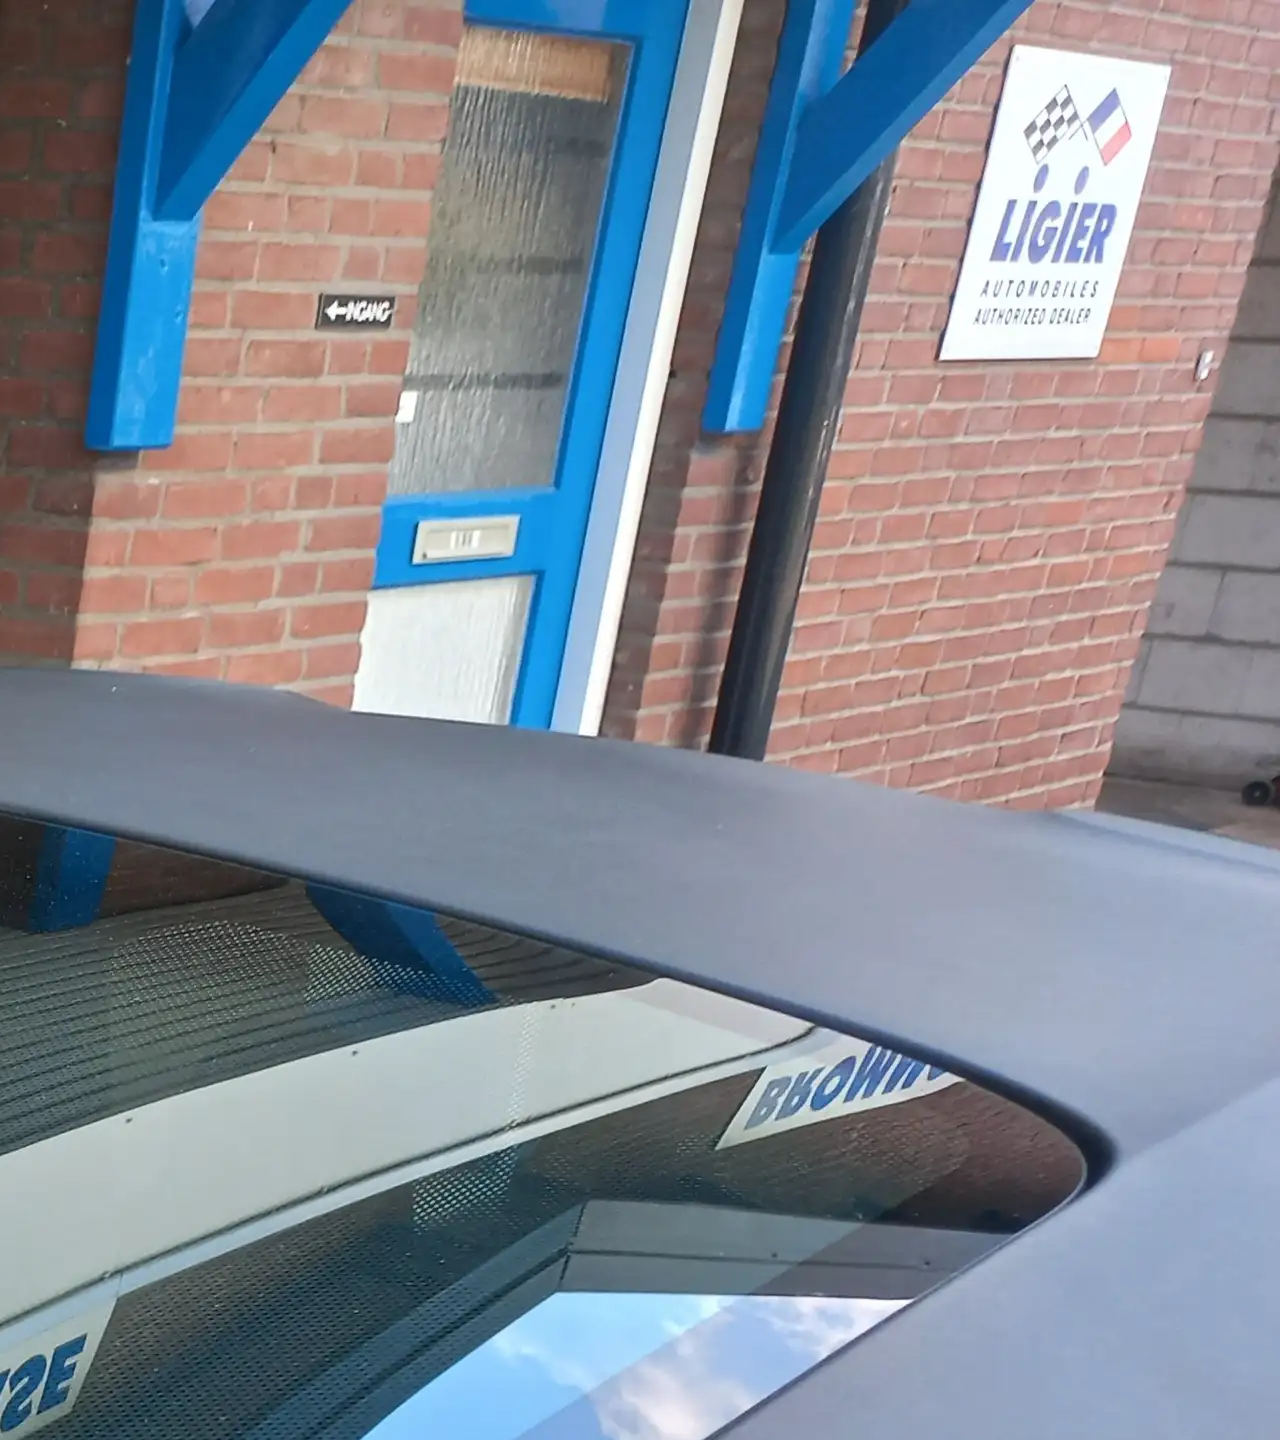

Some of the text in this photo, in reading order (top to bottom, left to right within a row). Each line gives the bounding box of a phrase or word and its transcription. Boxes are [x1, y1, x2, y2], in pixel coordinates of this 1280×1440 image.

[989, 199, 1118, 265] LIGIER
[980, 280, 1099, 298] AUTOMOBILES
[973, 307, 1091, 325] AUTHORIZED DEALER
